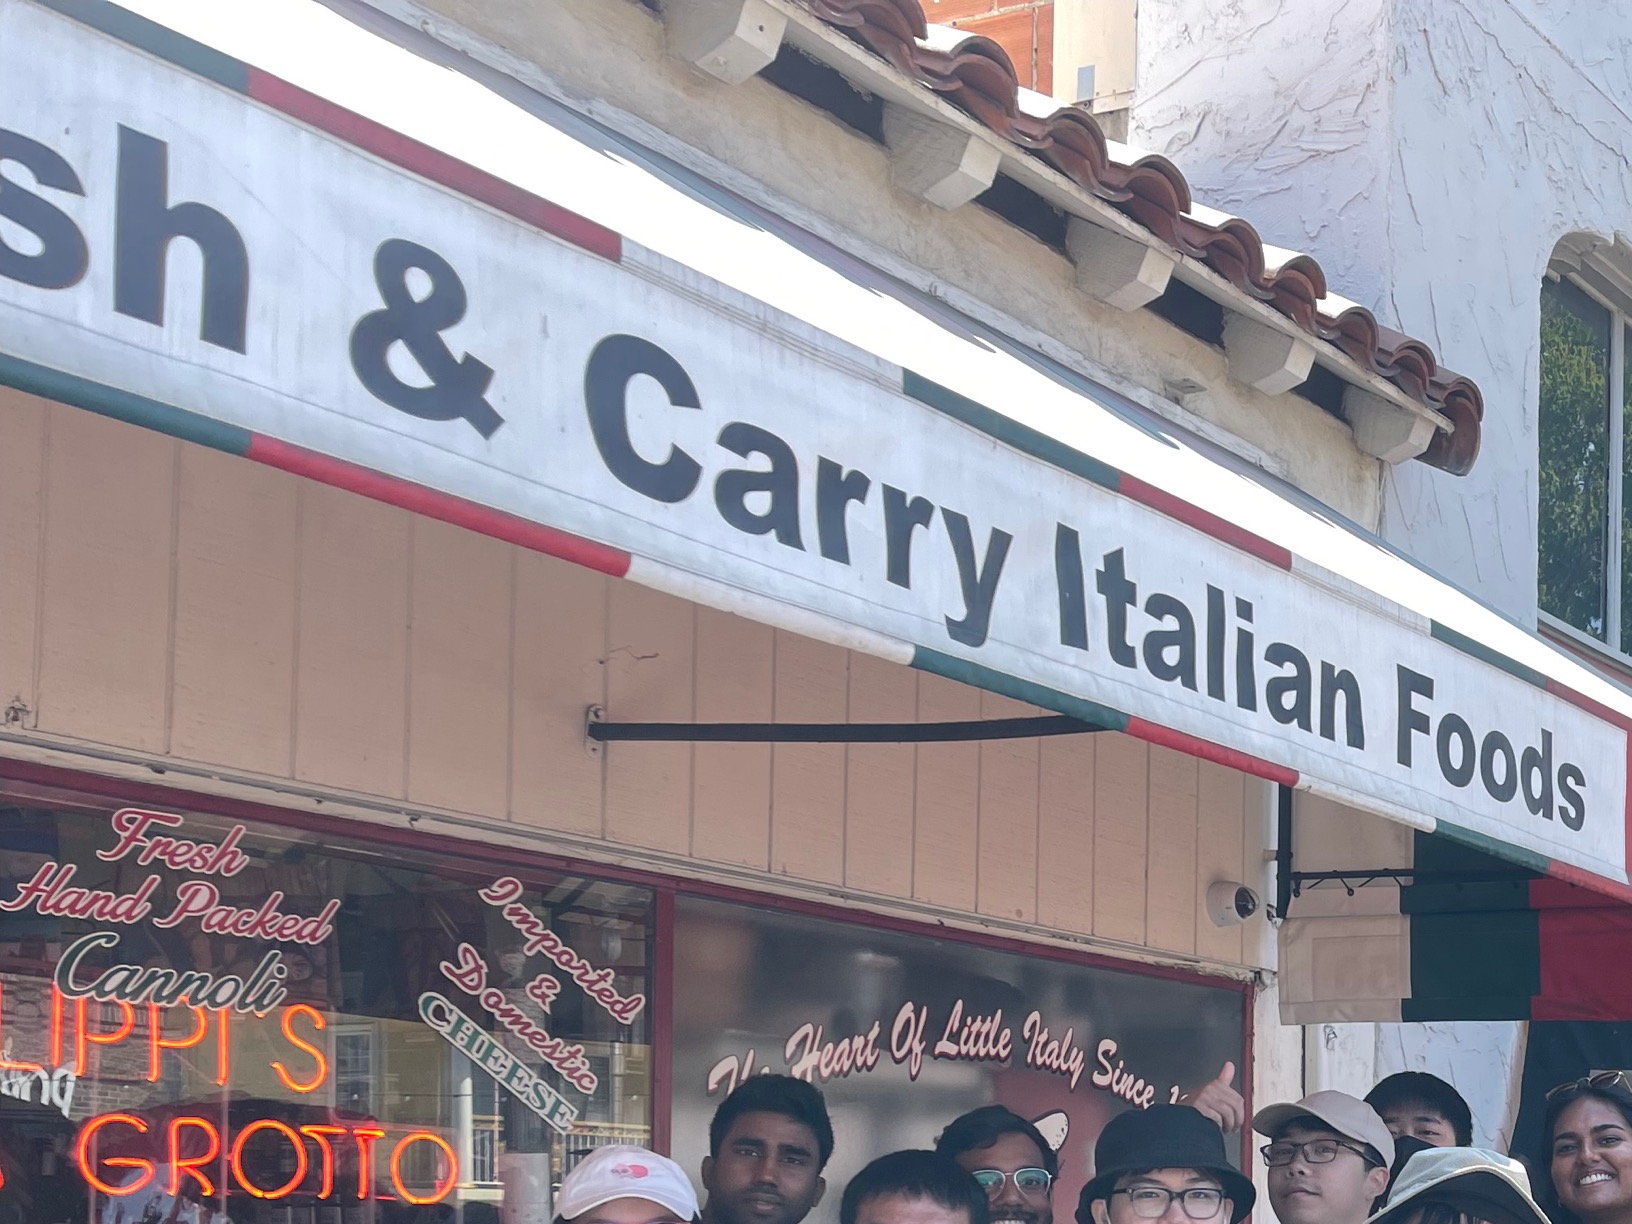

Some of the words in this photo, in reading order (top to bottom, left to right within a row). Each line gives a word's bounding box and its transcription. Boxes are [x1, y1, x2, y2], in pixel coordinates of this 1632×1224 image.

[0, 123, 250, 354] sh
[350, 238, 506, 441] &
[584, 334, 1013, 647] Carry
[1055, 522, 1365, 750] Italian
[1396, 663, 1586, 832] Foods
[97, 808, 249, 876] Fresh
[0, 862, 160, 923] Hand
[153, 880, 340, 944] Packed
[478, 876, 645, 1025] Imported
[55, 932, 288, 1013] Cannoli
[440, 943, 598, 1095] Domestic
[526, 974, 561, 1015] &
[0, 980, 328, 1093] LIPPIS
[419, 992, 579, 1135] CHEESE
[785, 1020, 880, 1084] Heart
[891, 1001, 928, 1081] Of
[934, 999, 1013, 1062] Little
[1022, 1010, 1084, 1092] Italy
[1092, 1038, 1155, 1110] Since
[78, 1114, 458, 1204] GROTTO
